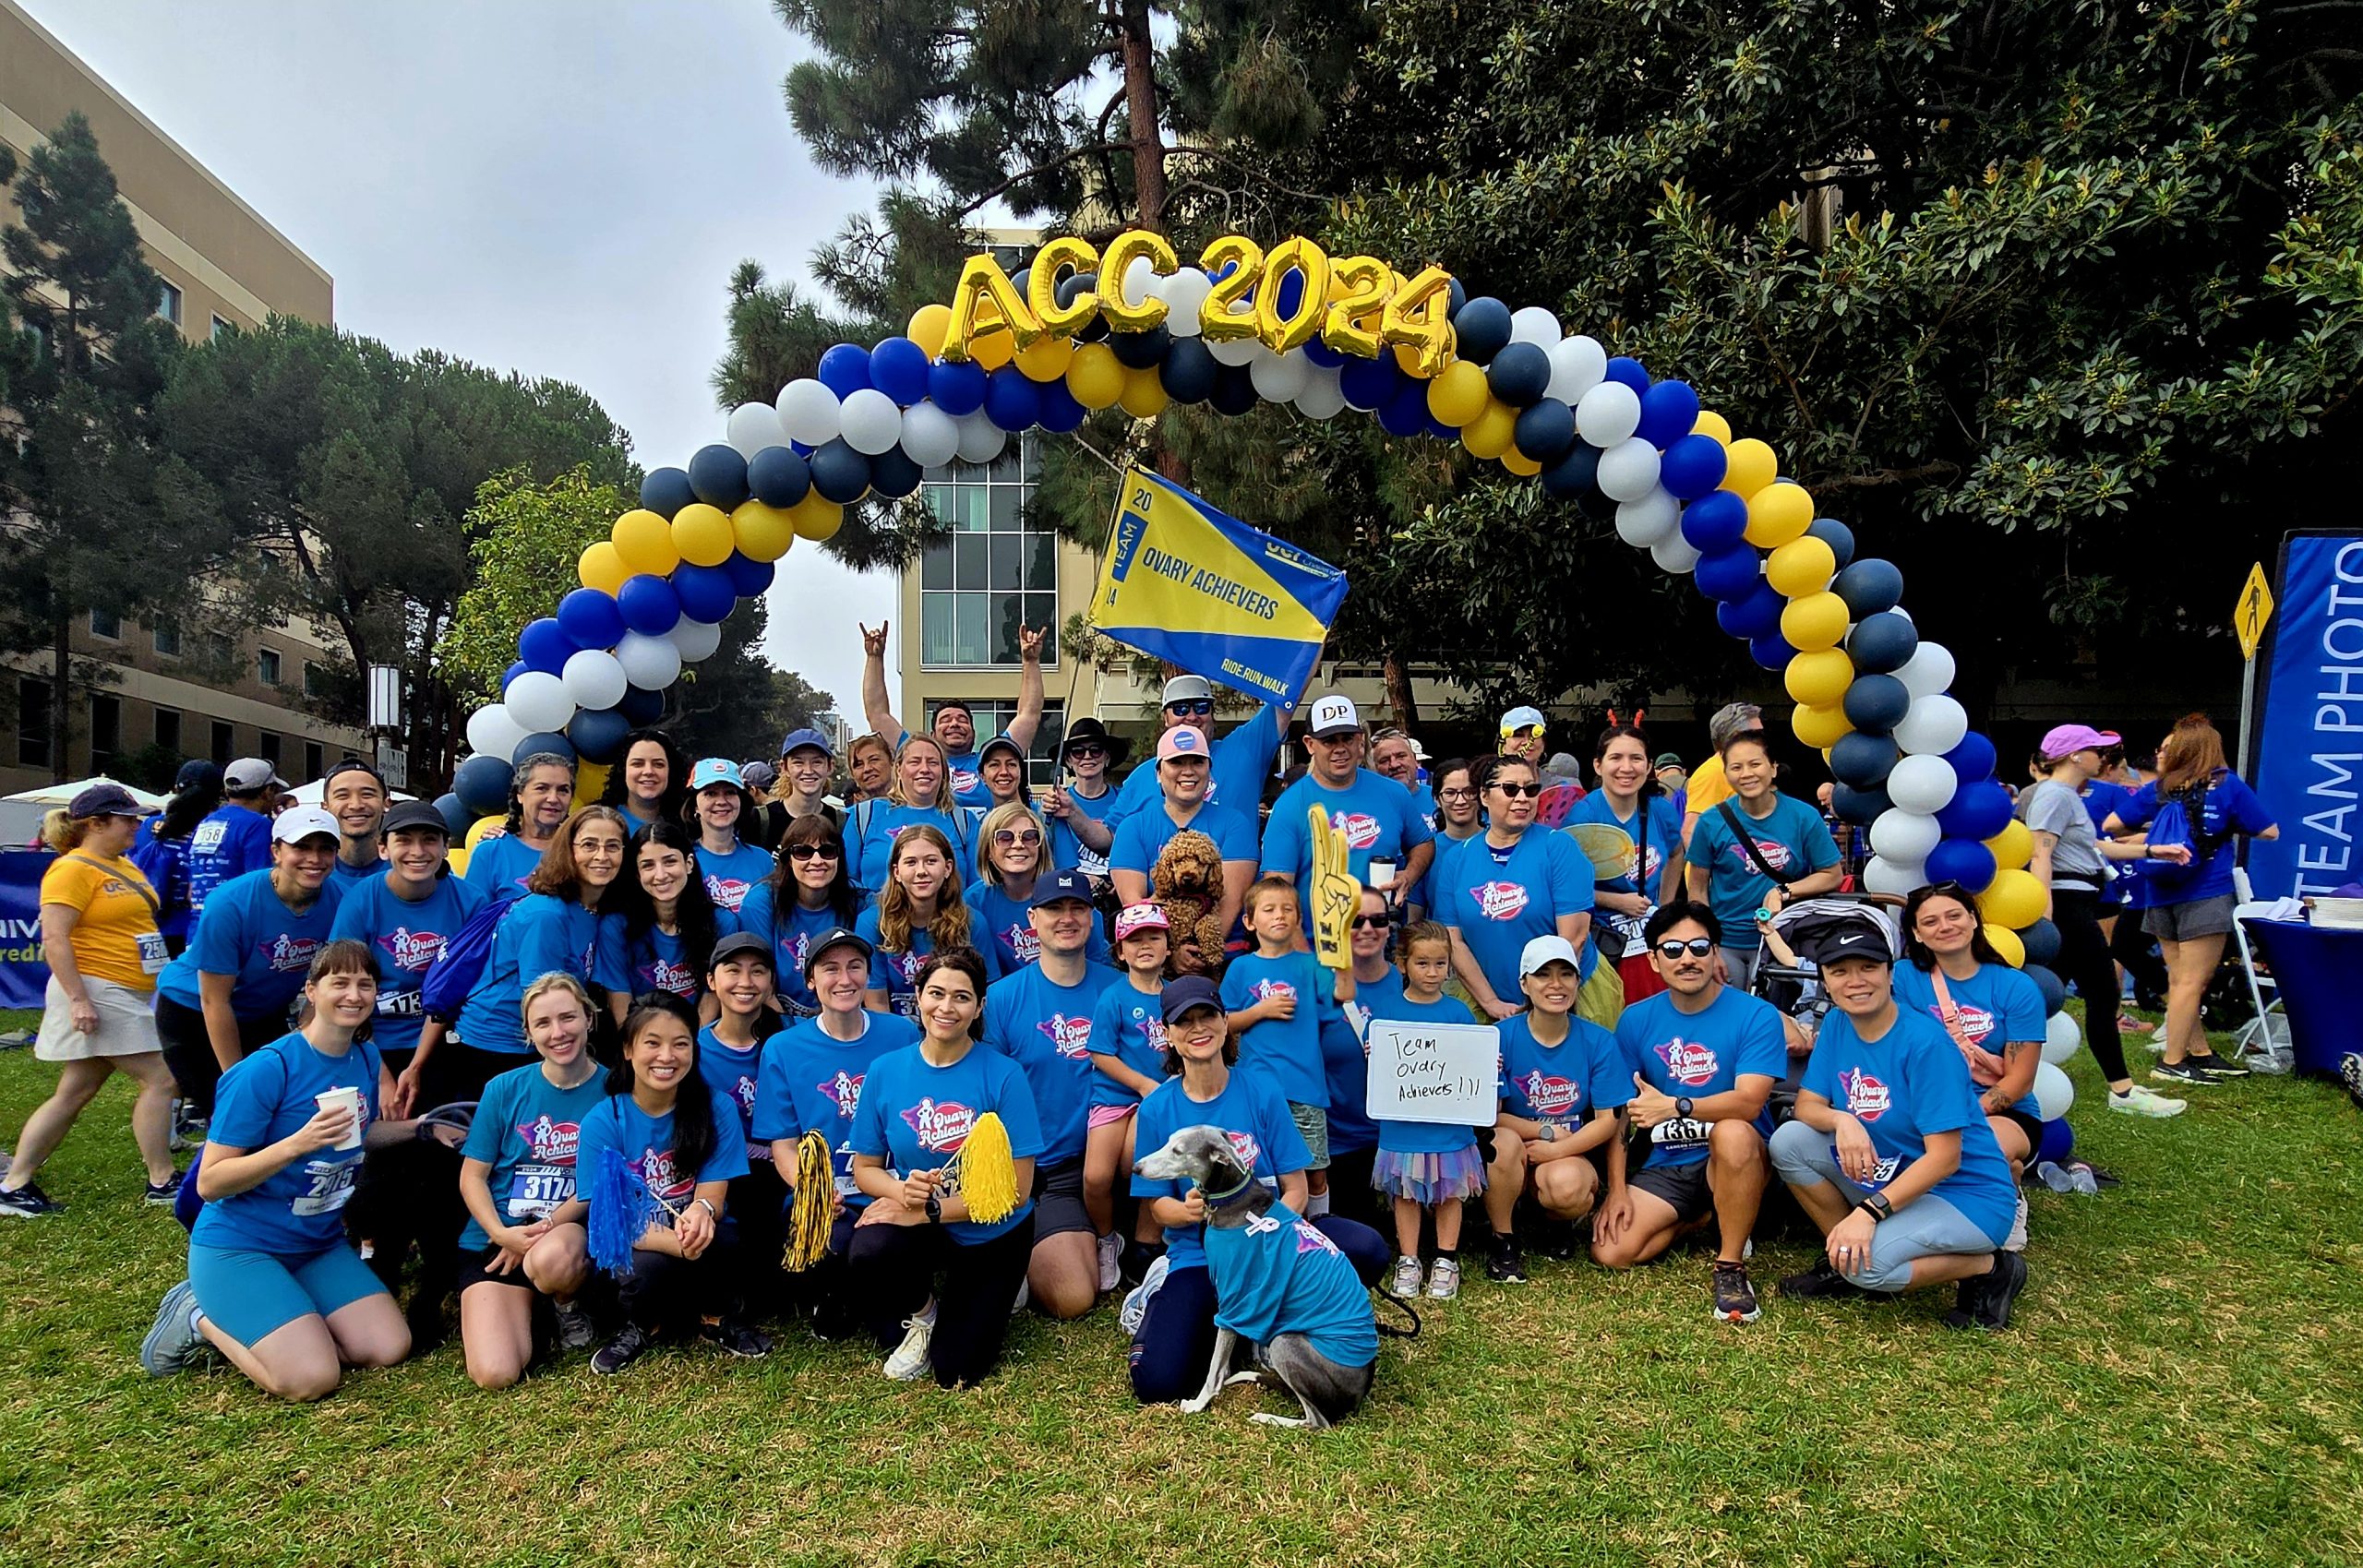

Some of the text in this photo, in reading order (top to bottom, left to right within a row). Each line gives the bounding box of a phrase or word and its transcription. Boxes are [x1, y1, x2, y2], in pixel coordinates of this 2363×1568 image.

[940, 230, 1452, 378] ACC 2024
[1132, 488, 1153, 511] 20
[1143, 546, 1279, 620] OVARY ACHIEVERS
[1220, 658, 1289, 697] RIDE.RUN.WALK
[2292, 753, 2363, 900] TEAM
[1387, 1032, 1437, 1060] Team
[1669, 1060, 1719, 1078] Achievers
[1683, 1050, 1716, 1067] Ovary
[1528, 1091, 1579, 1107] Achievers
[1541, 1081, 1577, 1098] Ovary
[1859, 1083, 1889, 1098] Ovary
[933, 1108, 974, 1129] Ovary
[524, 1176, 575, 1200] 3174
